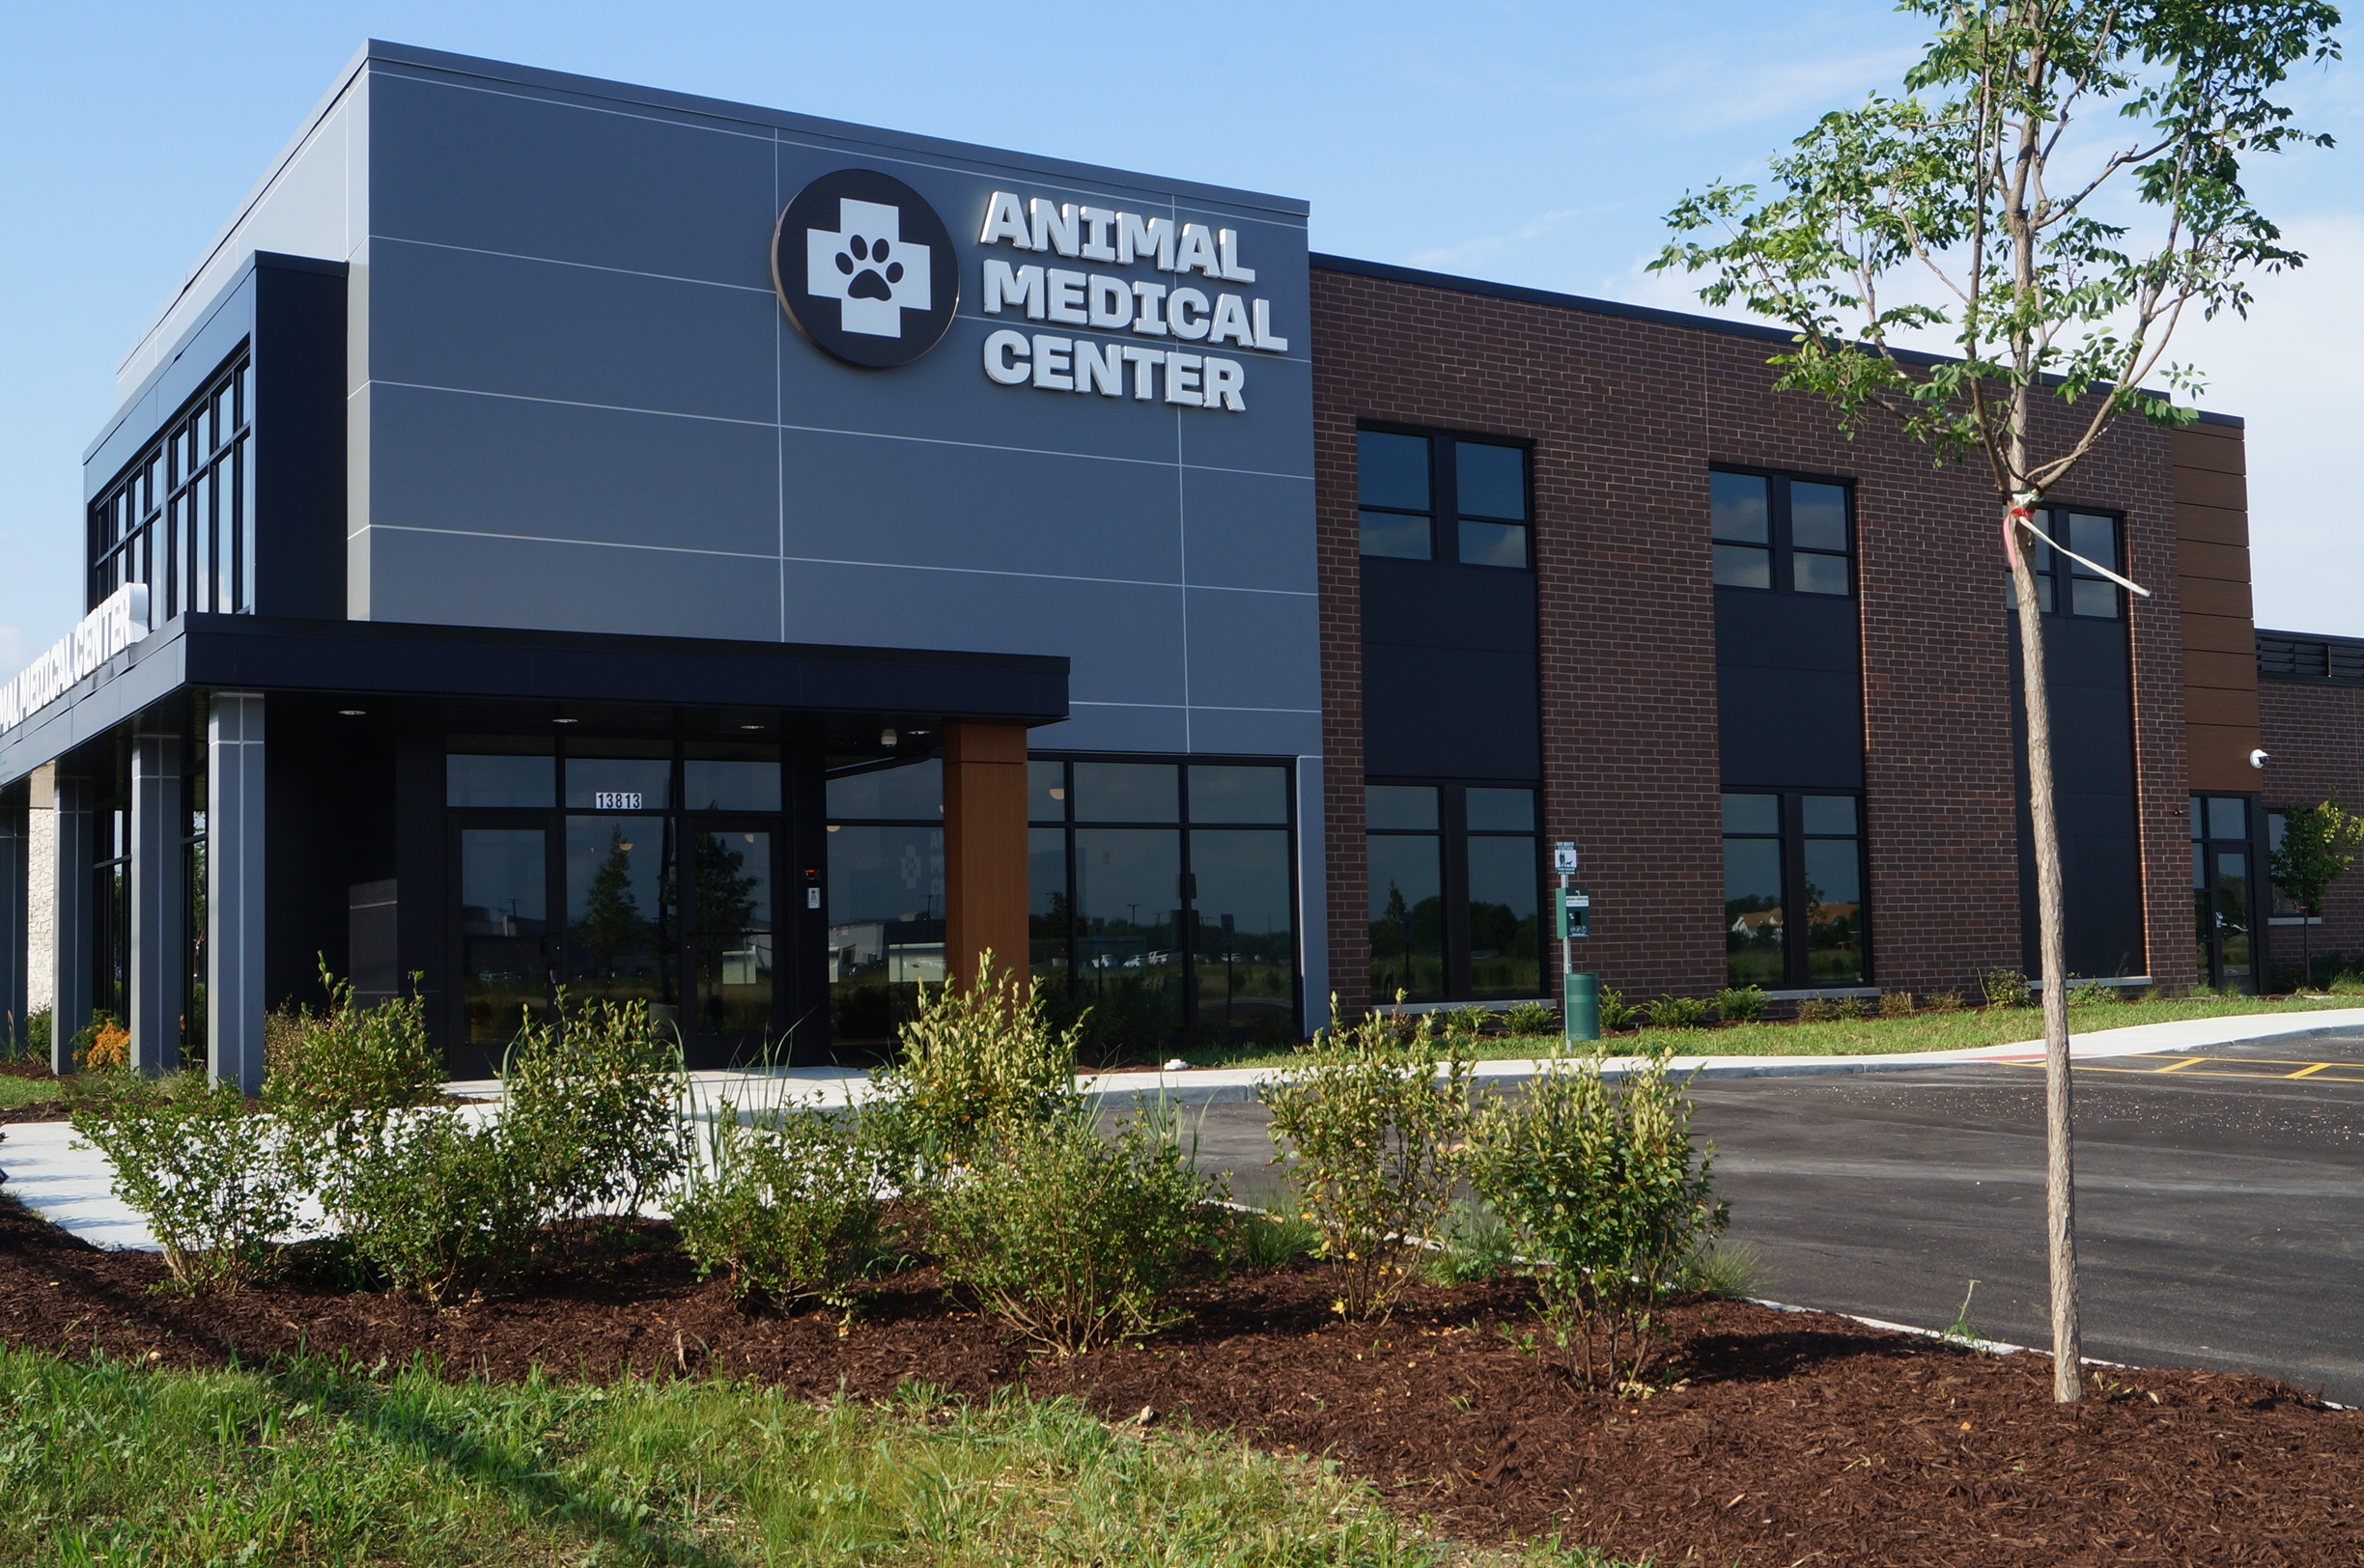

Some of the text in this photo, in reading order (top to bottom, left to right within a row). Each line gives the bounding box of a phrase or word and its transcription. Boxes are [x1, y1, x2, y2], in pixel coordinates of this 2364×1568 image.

[980, 191, 1255, 284] ANIMAL
[983, 259, 1288, 352] MEDICAL
[983, 329, 1247, 411] CENTER
[19, 632, 74, 722] MEDICAL
[73, 582, 150, 682] CENTER
[598, 793, 640, 808] 13813
